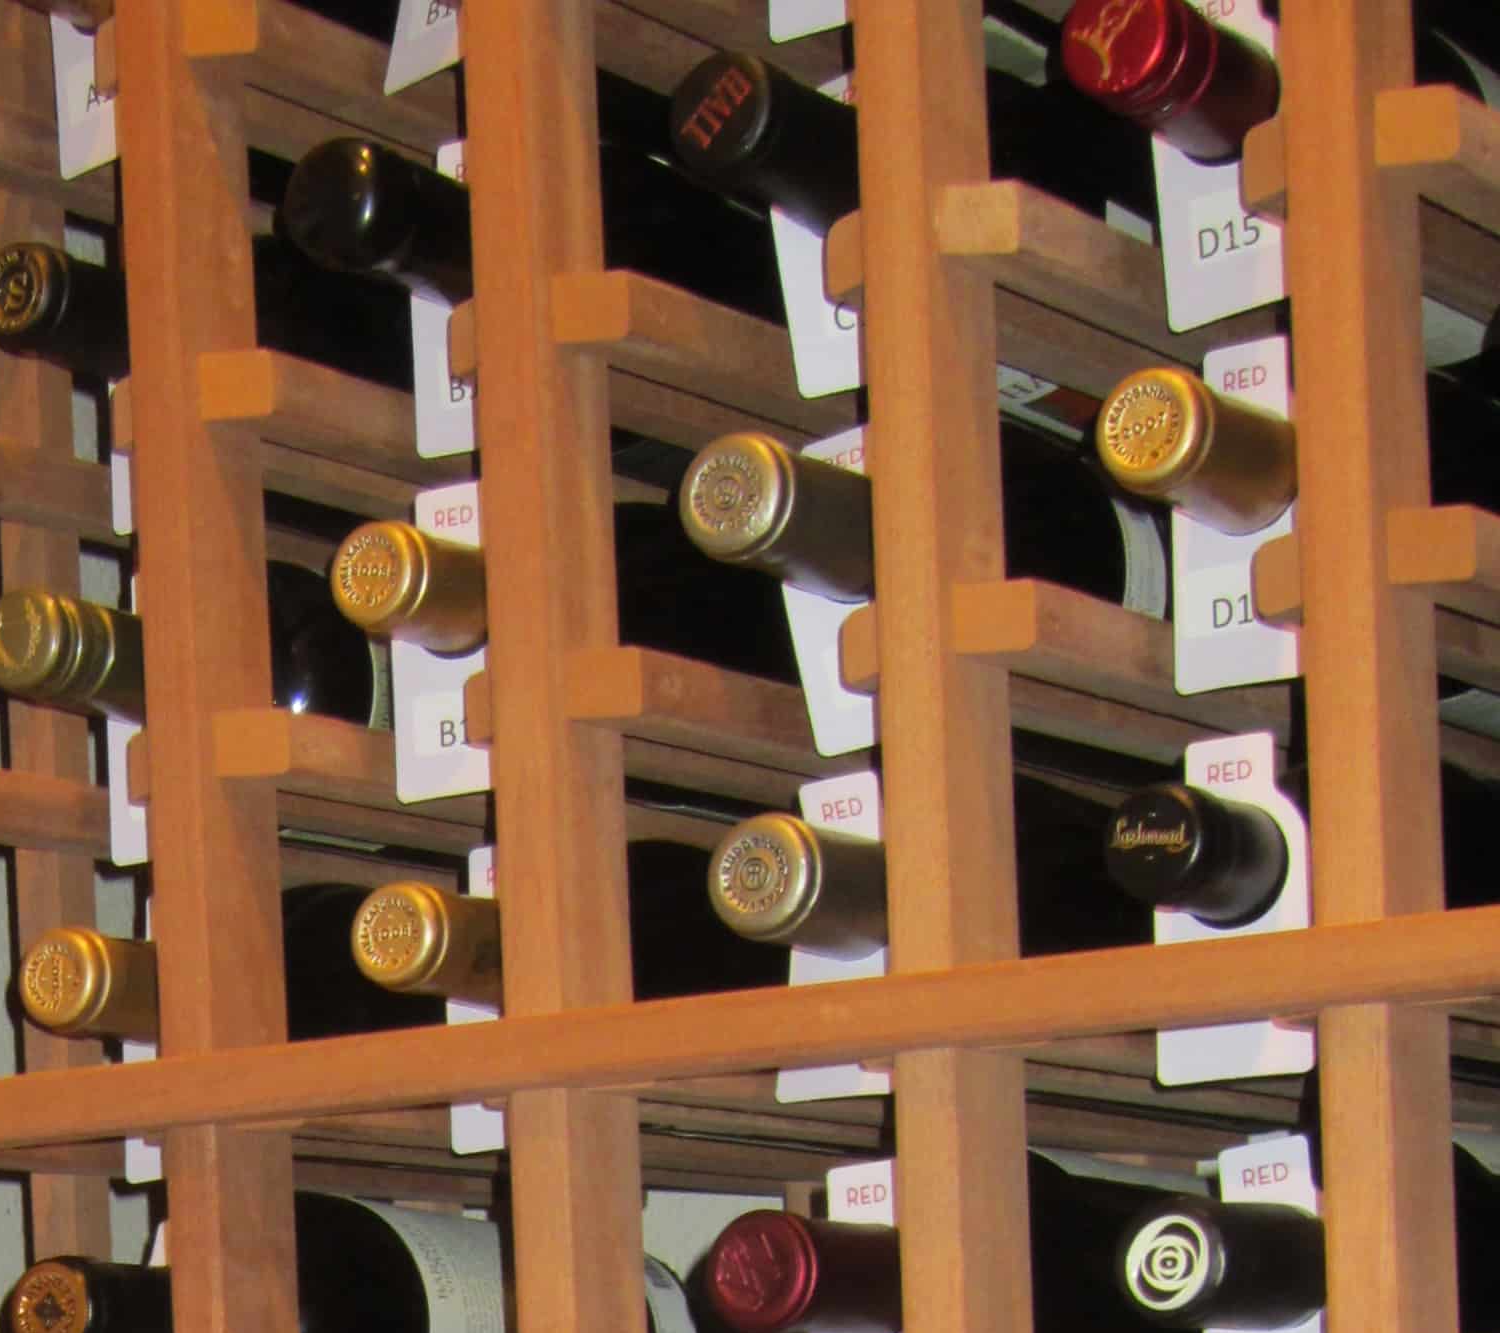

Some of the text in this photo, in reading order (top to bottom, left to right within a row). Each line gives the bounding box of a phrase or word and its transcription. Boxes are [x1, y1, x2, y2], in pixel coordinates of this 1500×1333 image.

[1197, 215, 1261, 260] D15
[1223, 365, 1268, 393] RED
[434, 505, 473, 529] RED
[1206, 759, 1253, 785] RED
[821, 798, 863, 823] RED
[1241, 1162, 1289, 1189] RED
[846, 1183, 887, 1208] RED
